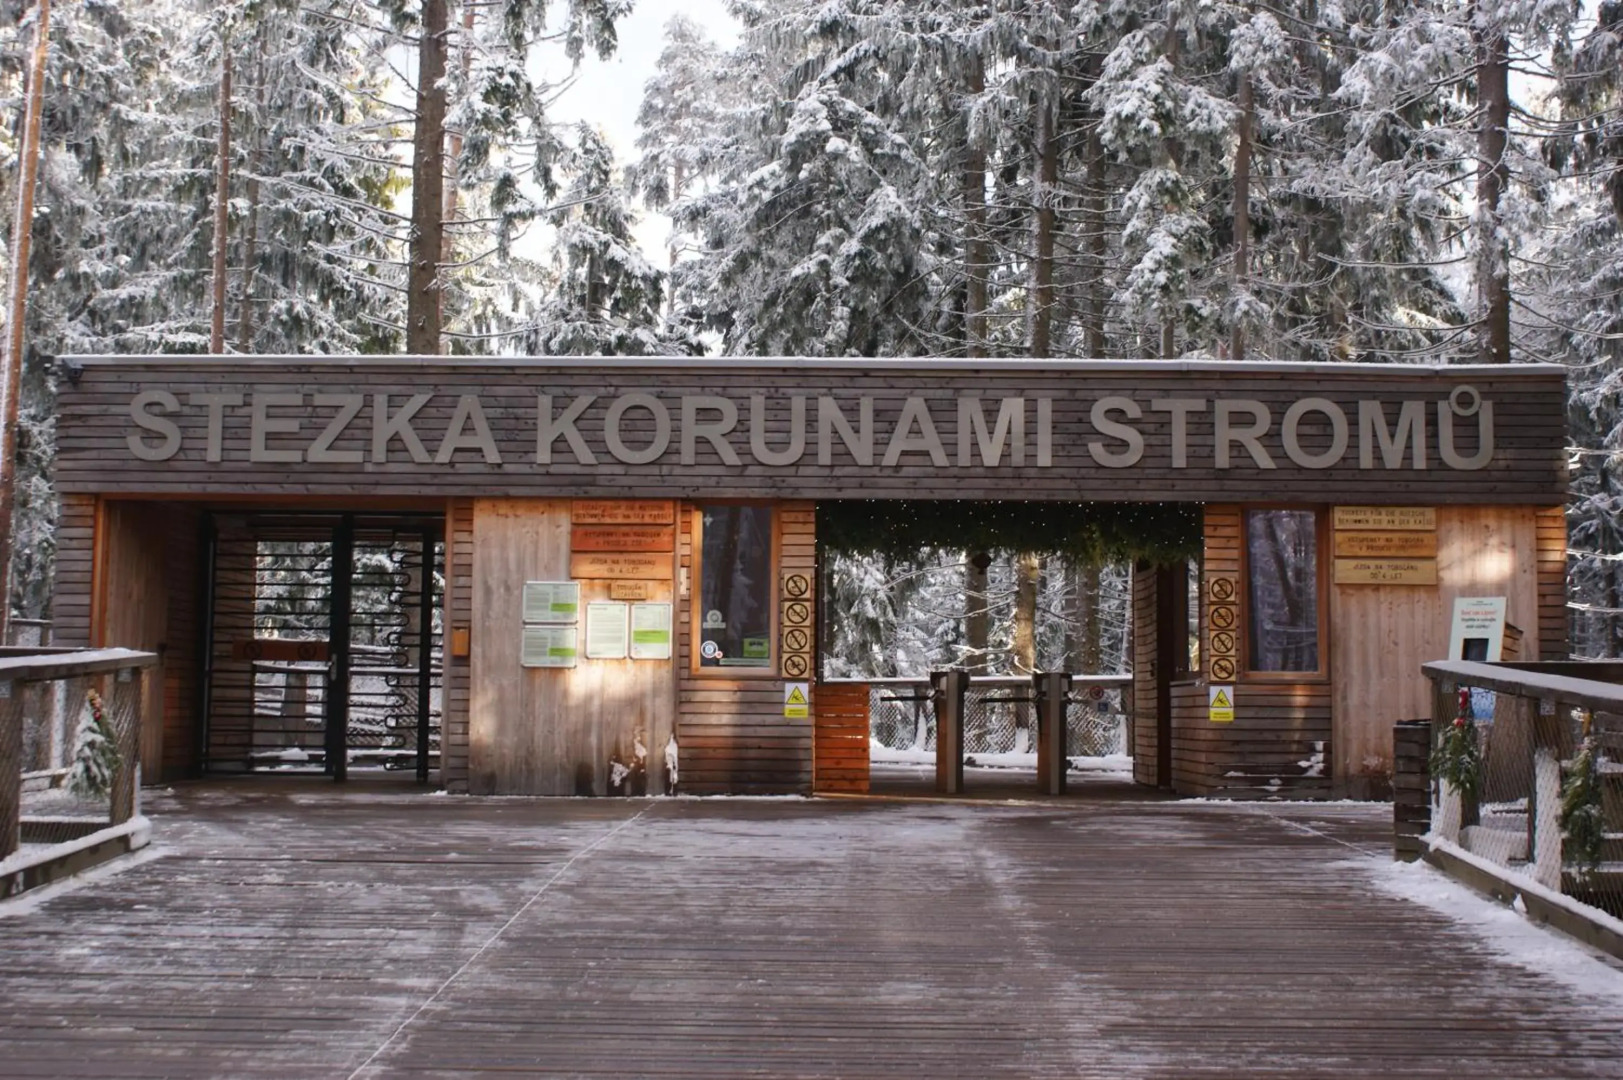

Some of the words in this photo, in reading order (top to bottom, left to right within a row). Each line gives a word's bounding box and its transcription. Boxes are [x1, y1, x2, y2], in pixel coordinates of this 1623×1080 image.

[125, 389, 503, 465] STEZKA
[535, 393, 1054, 468] KORUNAMI
[1088, 384, 1495, 471] STROMŮ
